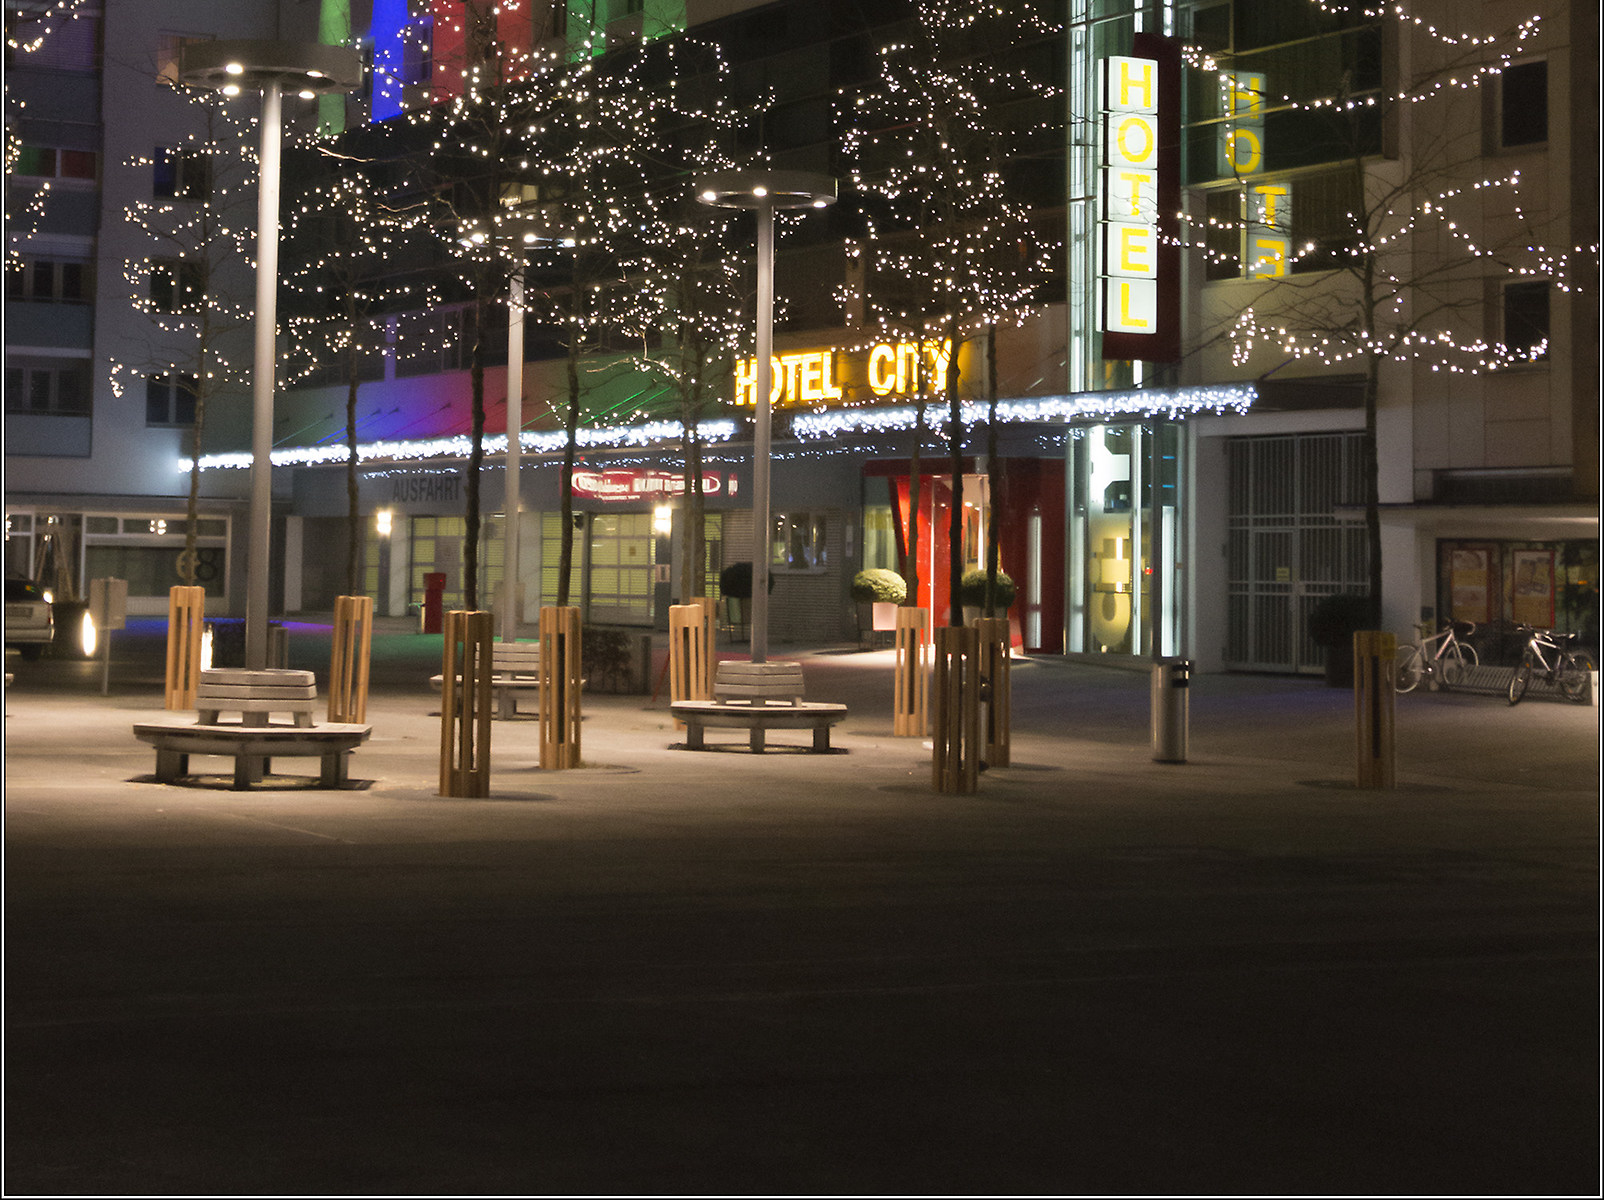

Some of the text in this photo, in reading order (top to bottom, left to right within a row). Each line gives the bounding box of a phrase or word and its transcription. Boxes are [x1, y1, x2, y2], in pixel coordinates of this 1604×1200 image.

[1117, 62, 1153, 328] HOTEL
[868, 338, 953, 396] CITY
[393, 475, 462, 502] AUSFAHRT
